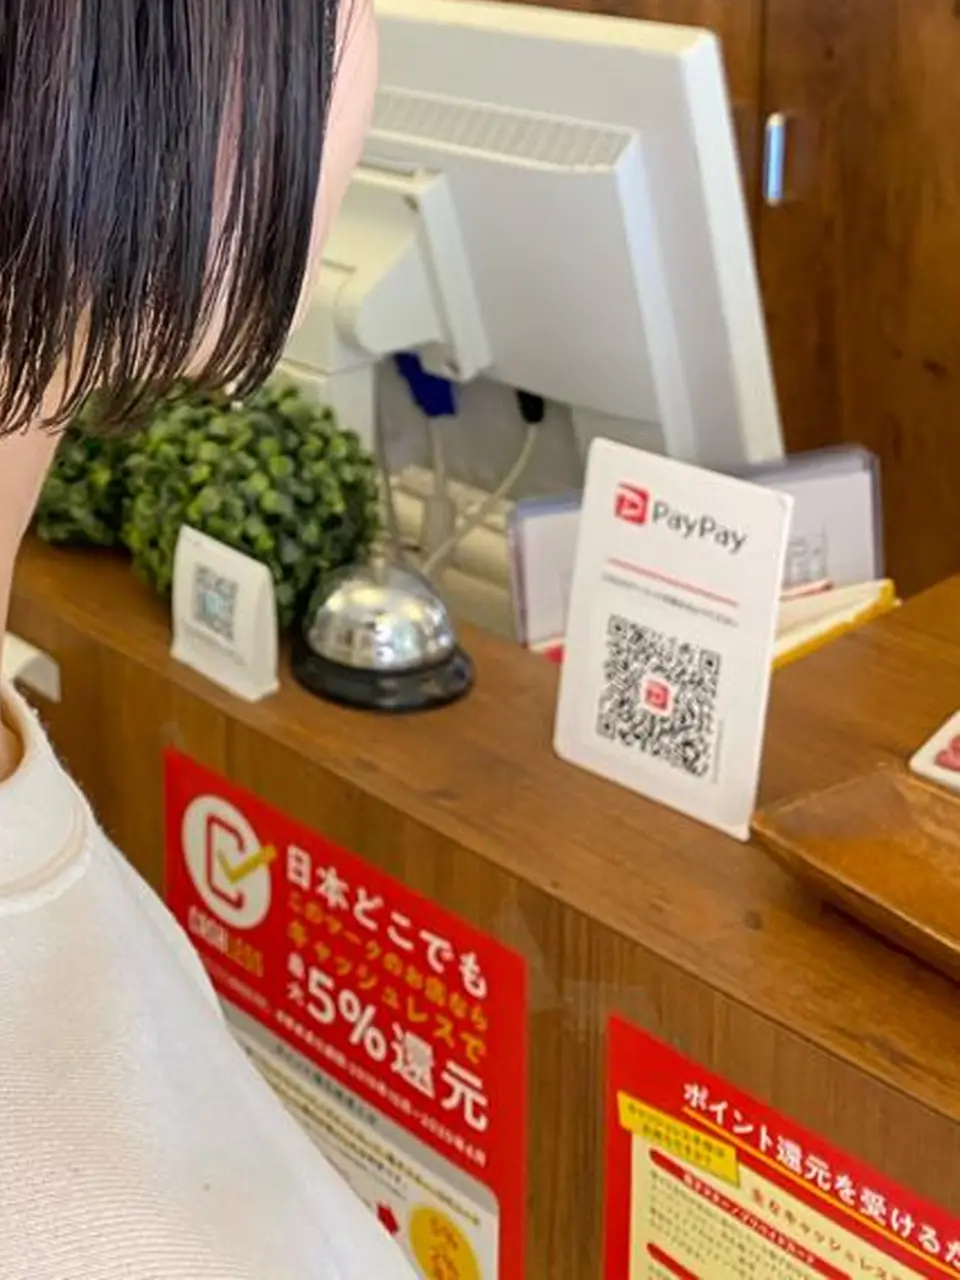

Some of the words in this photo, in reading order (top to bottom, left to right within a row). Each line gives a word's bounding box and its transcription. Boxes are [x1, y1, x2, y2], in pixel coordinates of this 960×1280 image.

[652, 500, 747, 554] PayPay
[287, 844, 487, 999] 日本どこでも
